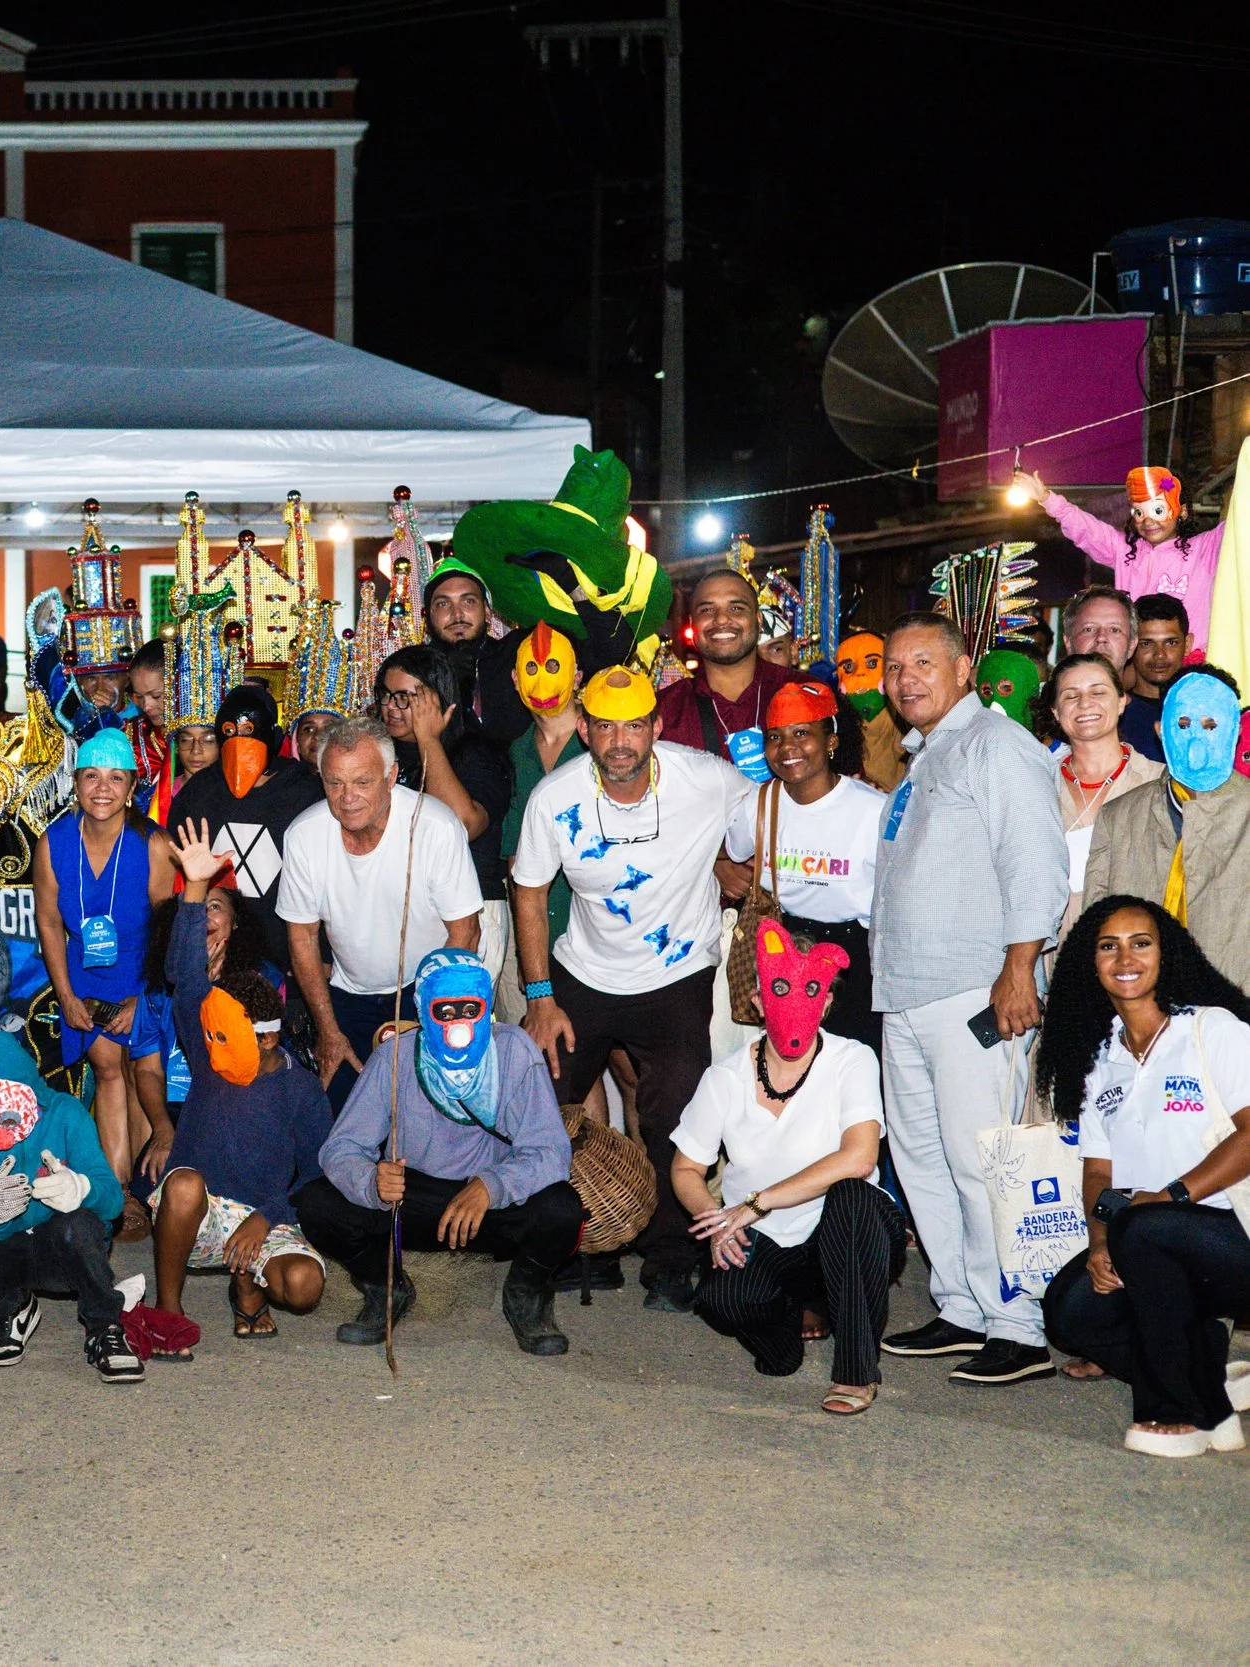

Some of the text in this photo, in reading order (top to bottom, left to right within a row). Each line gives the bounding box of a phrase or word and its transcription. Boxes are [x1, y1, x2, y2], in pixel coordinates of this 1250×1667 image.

[765, 852, 850, 876] MAÇARI
[1165, 1080, 1201, 1093] MATA
[1163, 1099, 1204, 1112] JOÃO
[1023, 1210, 1078, 1226] BANDEIRA
[1025, 1224, 1052, 1237] AZUL
